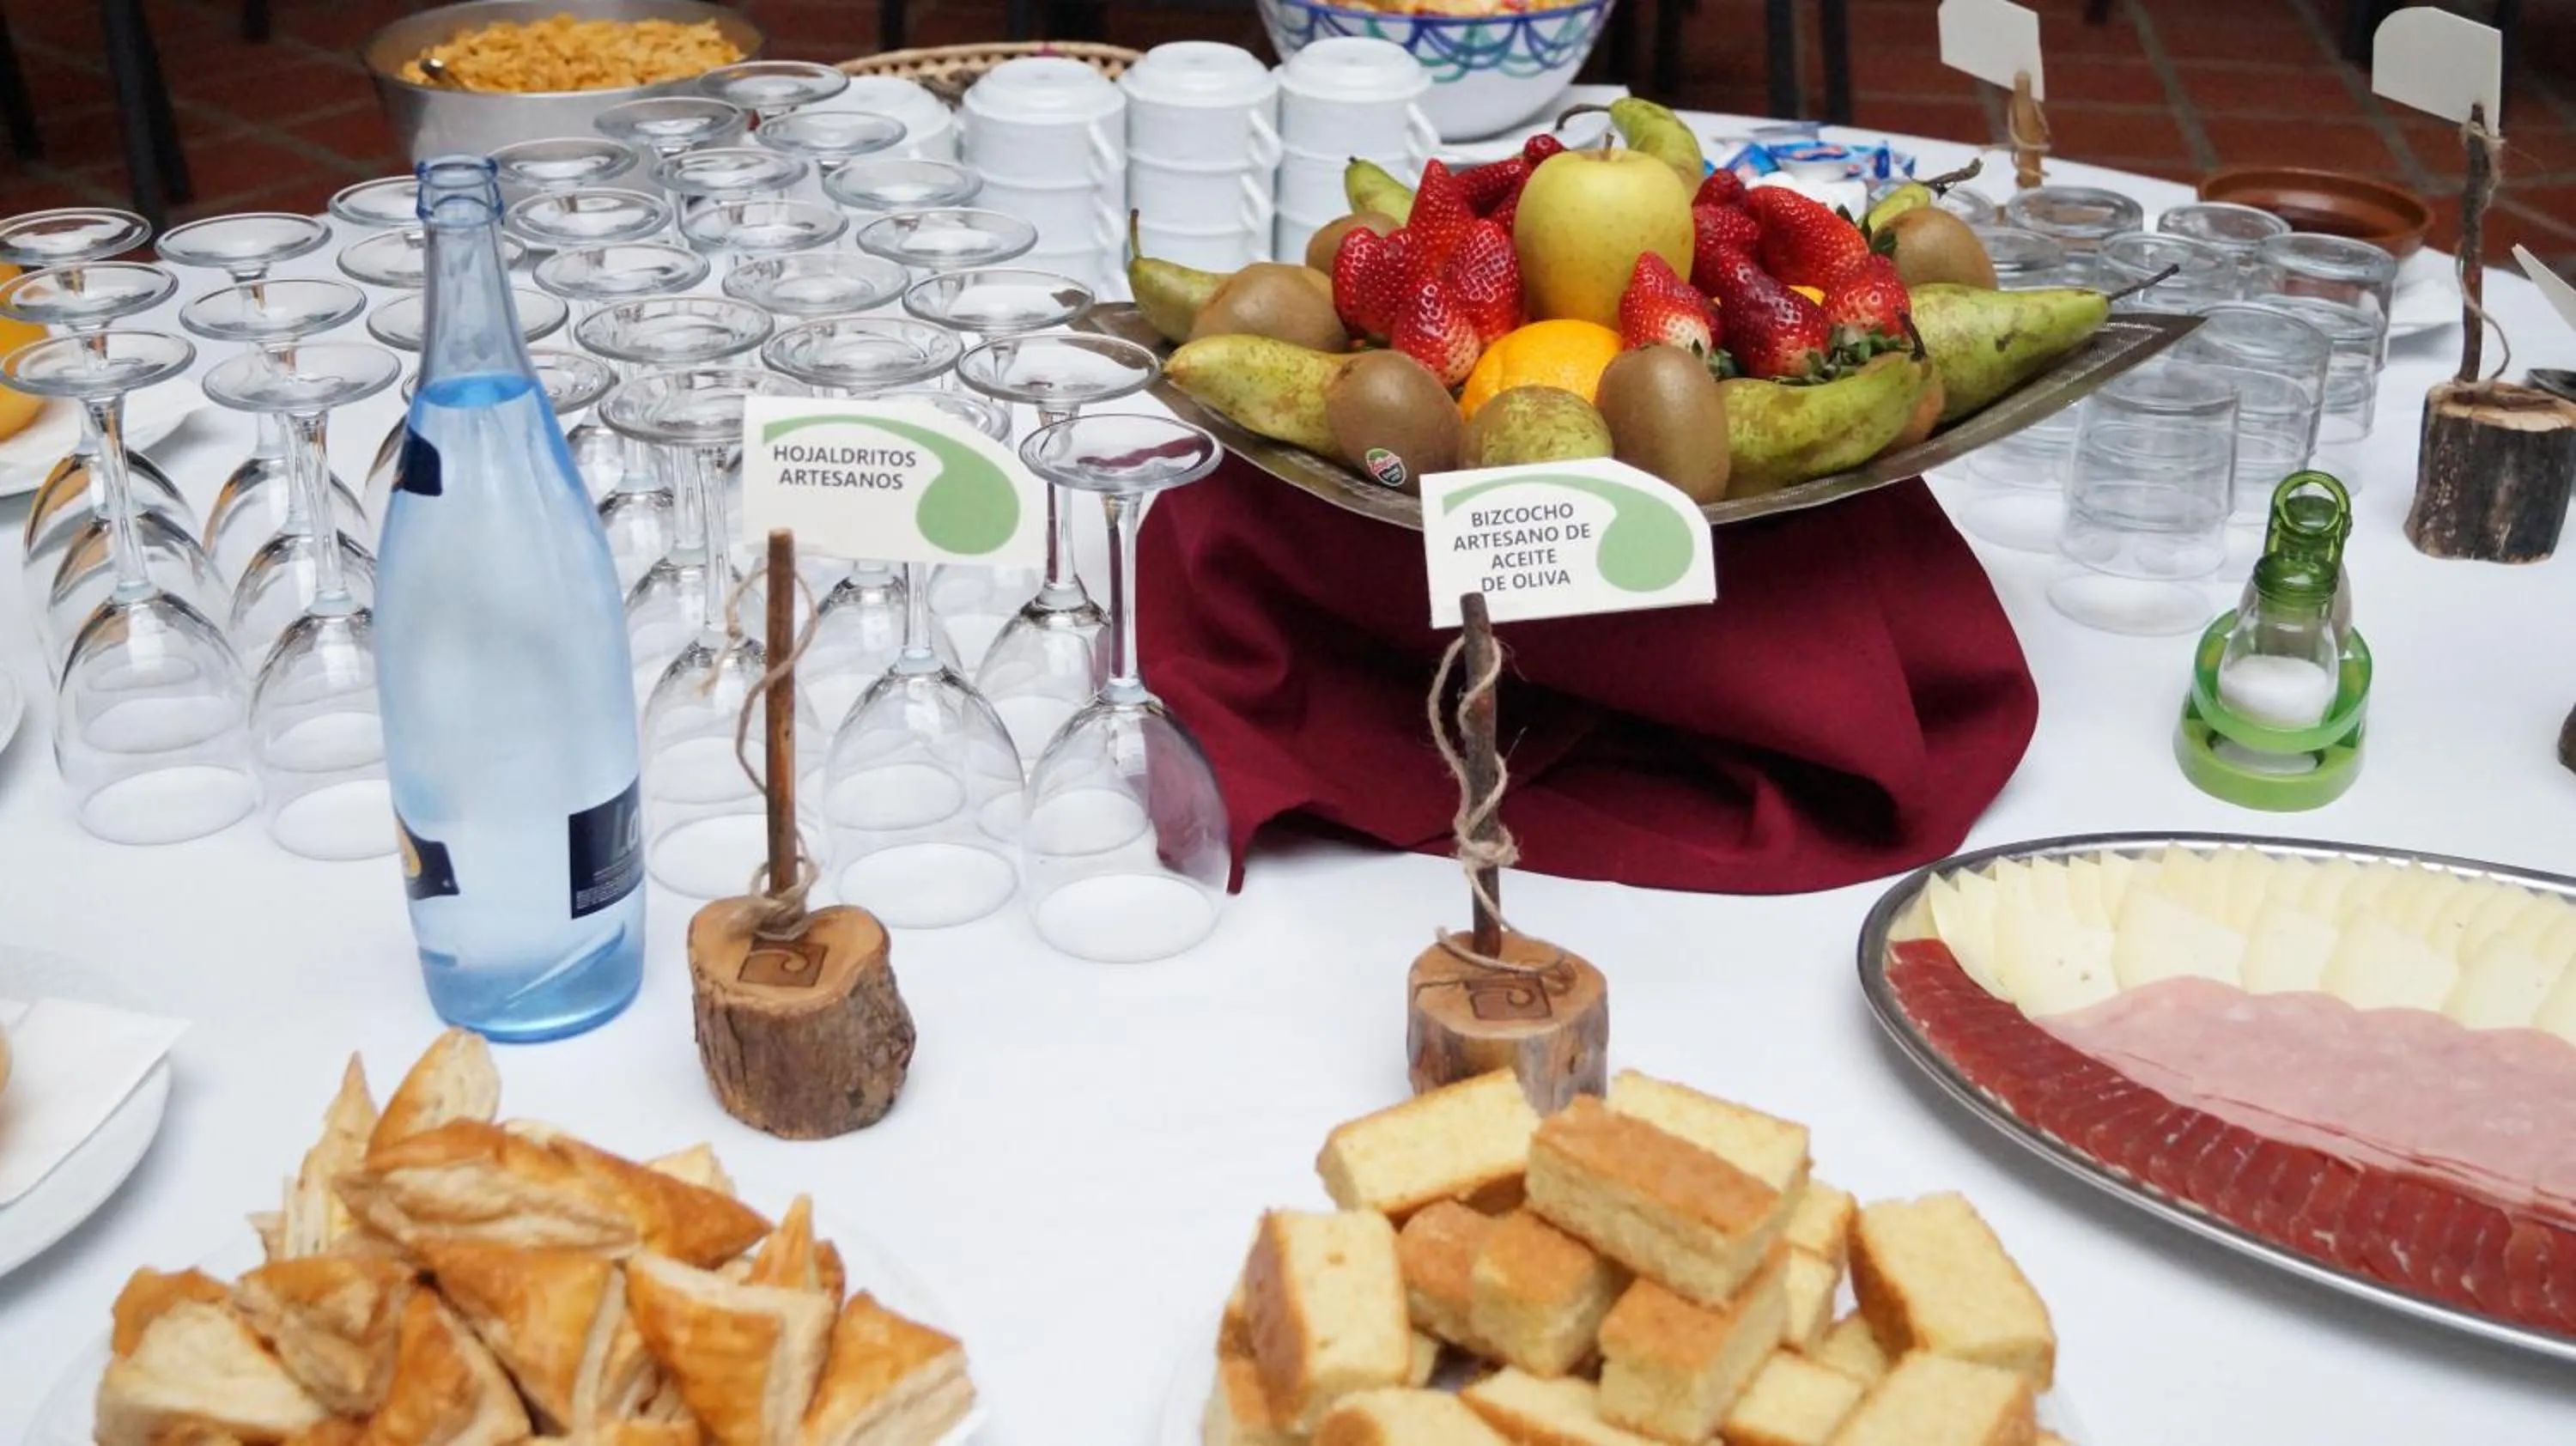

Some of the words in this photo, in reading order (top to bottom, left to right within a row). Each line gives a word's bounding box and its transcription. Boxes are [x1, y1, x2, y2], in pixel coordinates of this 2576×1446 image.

[774, 445, 916, 467] HOJALDRITOS
[779, 469, 903, 489] ARTESANOS
[1472, 503, 1574, 526] BIZCOCHO
[1454, 527, 1559, 550] ARTESANO
[1565, 524, 1591, 540] DE
[1492, 549, 1557, 569] ACEITE
[1481, 576, 1507, 592] DE
[1512, 569, 1571, 590] OLIVA
